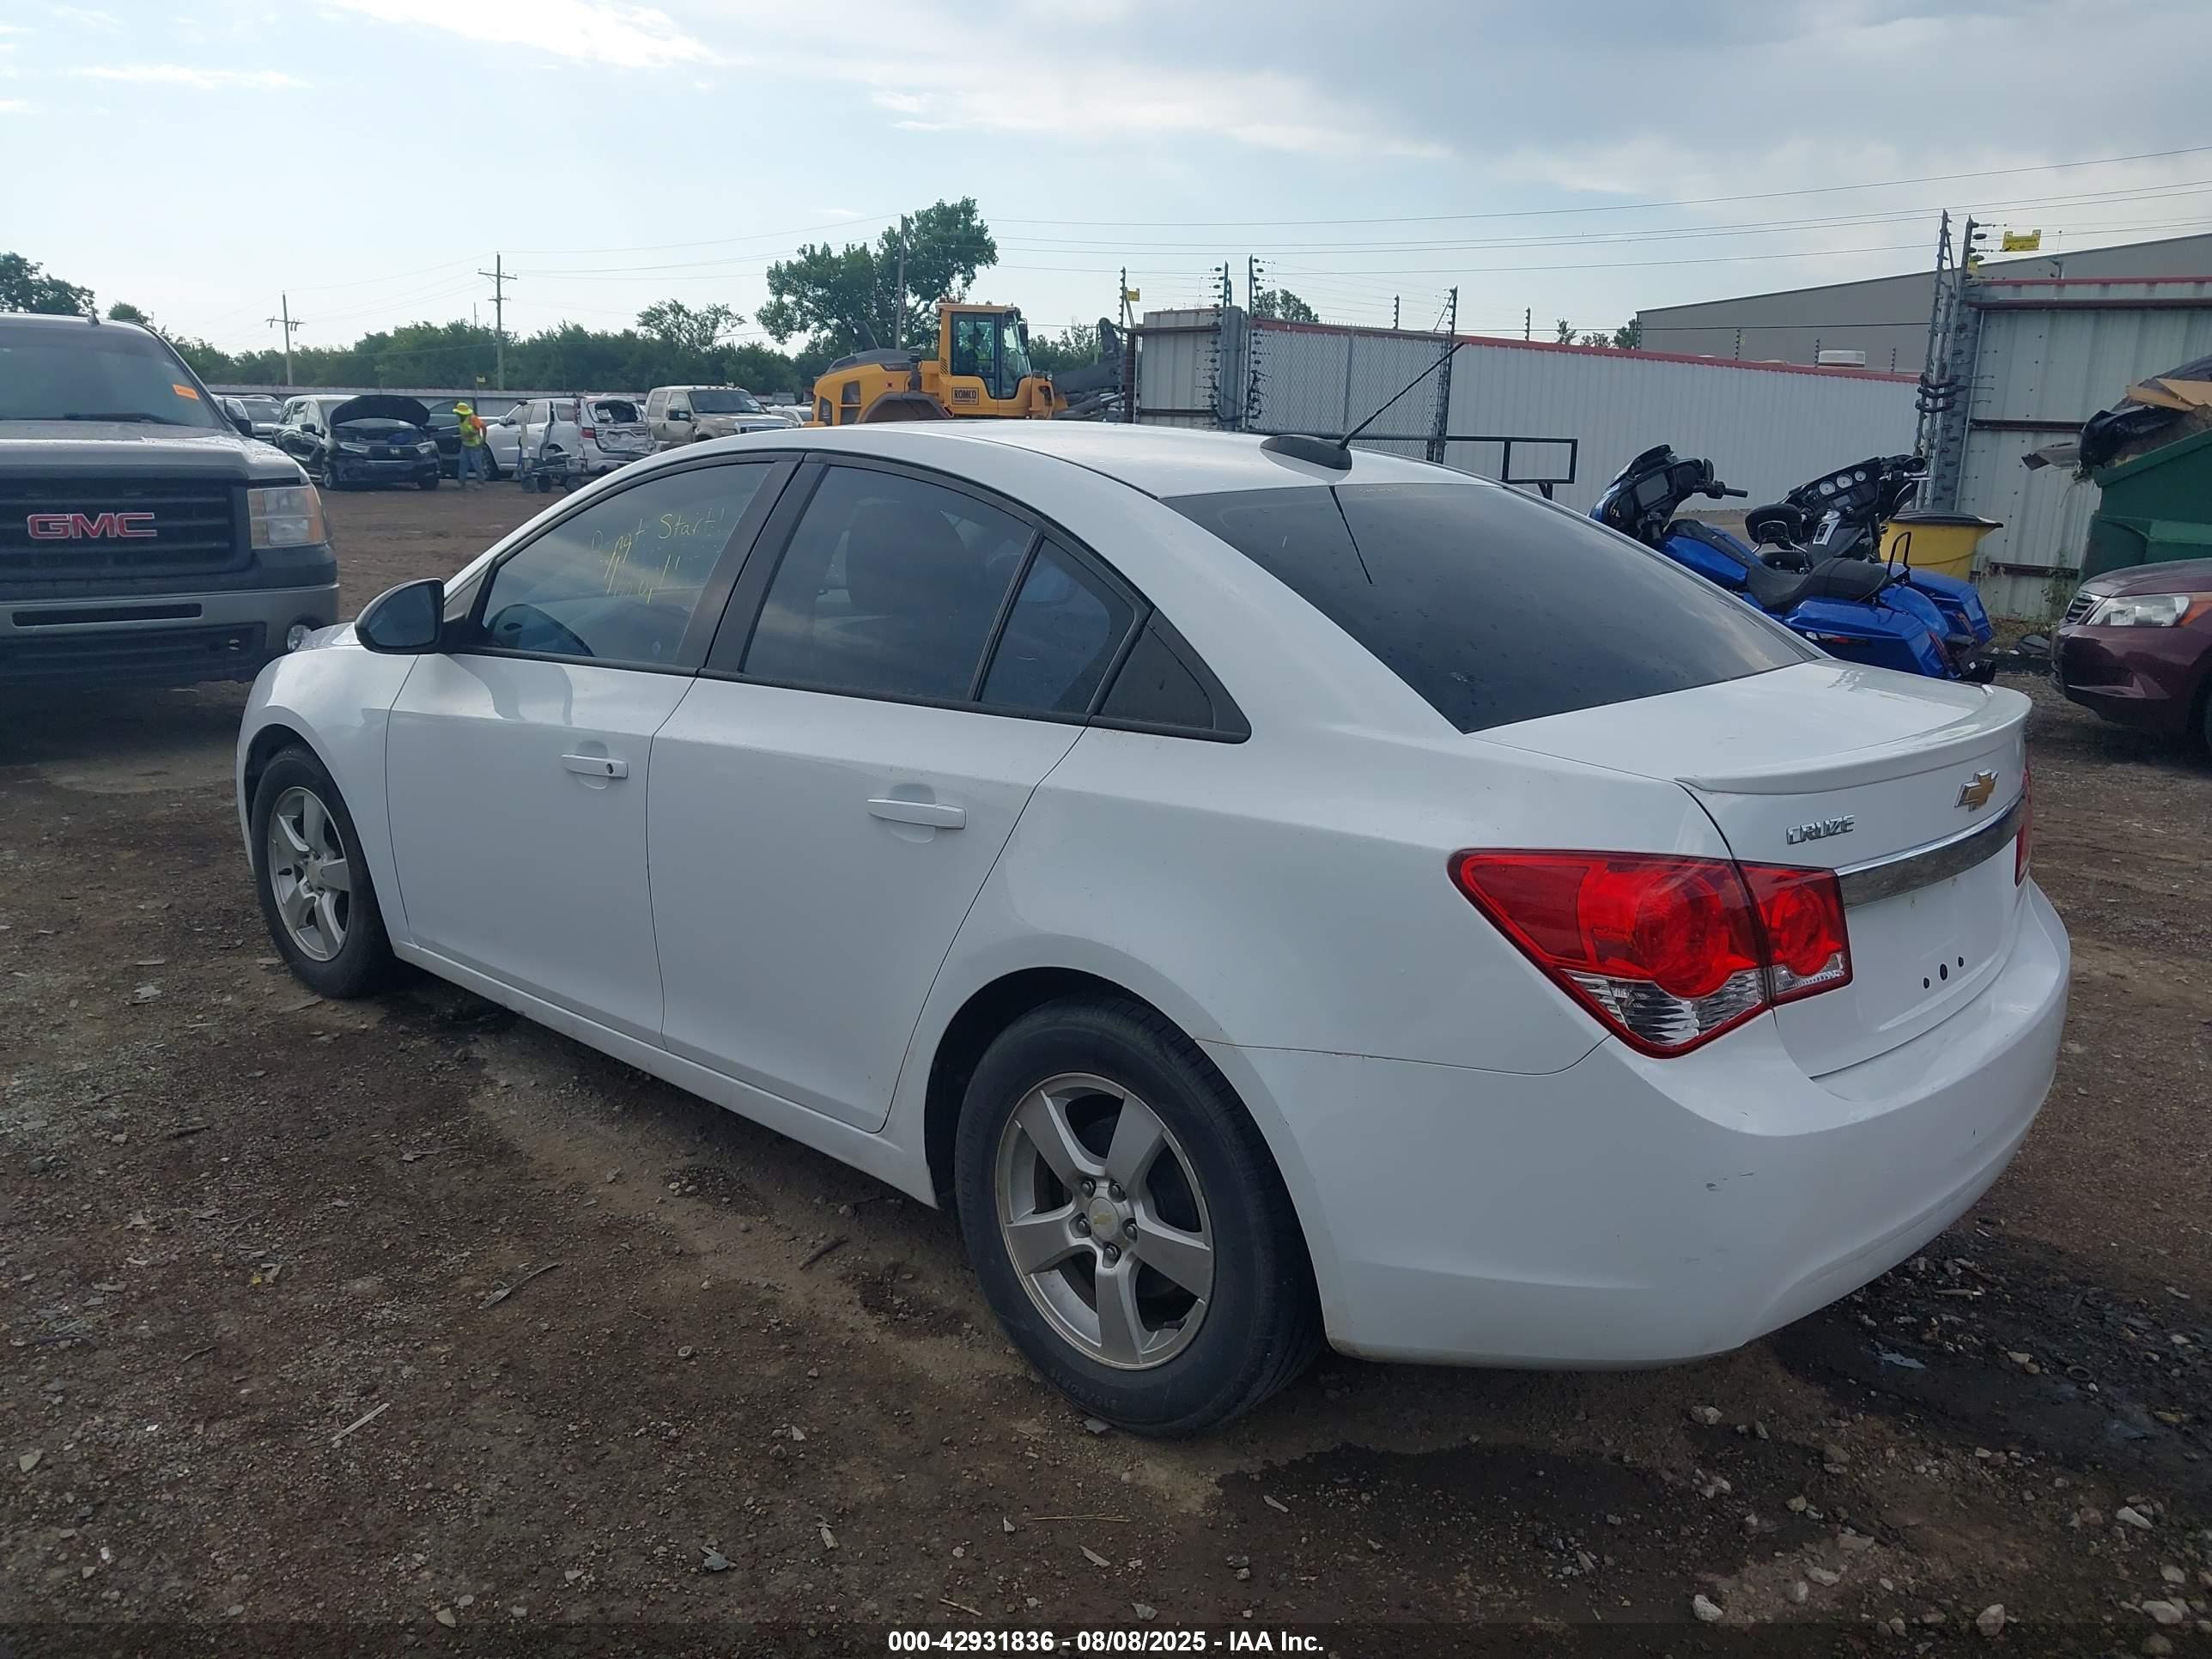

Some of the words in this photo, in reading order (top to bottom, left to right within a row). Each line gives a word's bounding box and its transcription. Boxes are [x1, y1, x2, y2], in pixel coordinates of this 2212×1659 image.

[954, 389, 976, 399] ROMCO
[27, 513, 158, 539] GMC
[1786, 814, 1856, 845] CRUZE
